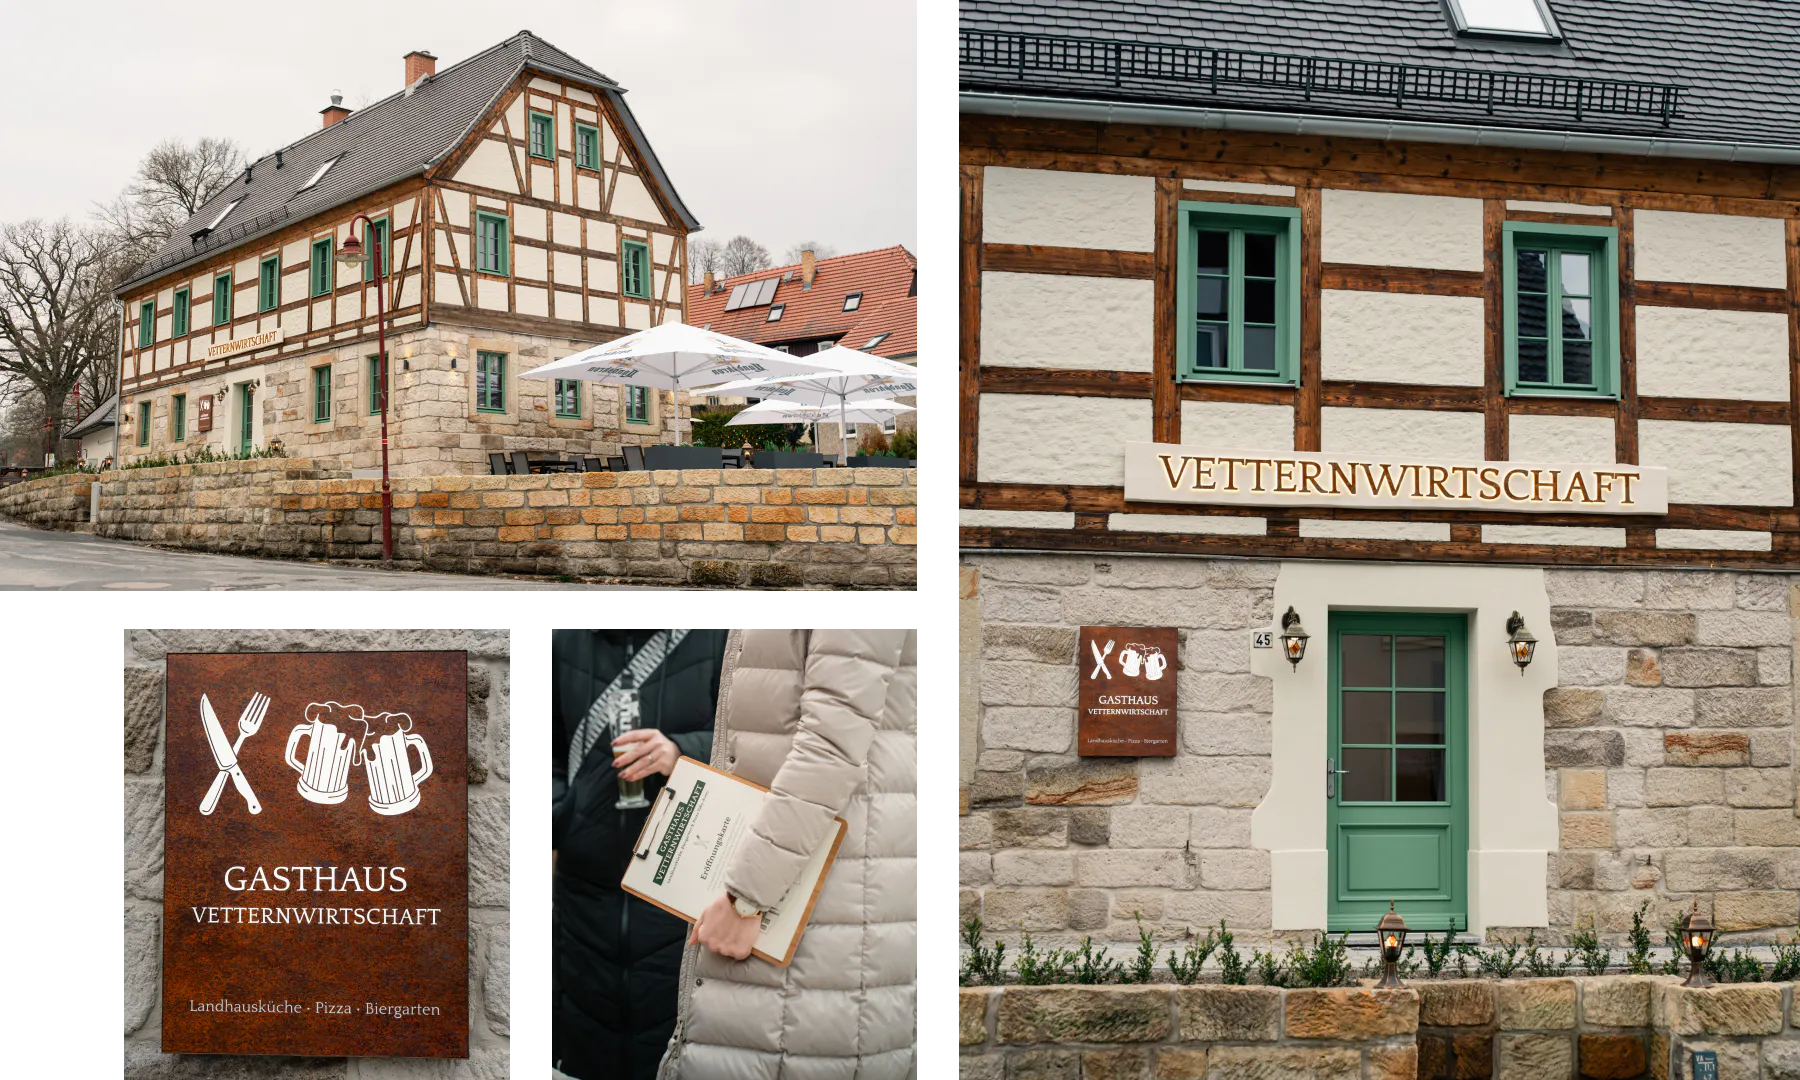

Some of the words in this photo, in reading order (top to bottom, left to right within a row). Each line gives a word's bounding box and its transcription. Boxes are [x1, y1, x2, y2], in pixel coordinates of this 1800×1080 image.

[207, 330, 278, 357] VETTERNWIRTSCHAFT
[1158, 454, 1641, 504] VETTERNWIRTSCHAFT
[1256, 634, 1271, 646] 45
[1088, 708, 1169, 716] VETTERNWIRTSCHAFT
[1098, 695, 1159, 705] GASTHAUS
[655, 783, 703, 882] VETTERNWIRTSCHAFT
[659, 805, 685, 853] GASTHAUS
[699, 815, 732, 881] Eröffnungskarte
[224, 866, 408, 893] GASTHAUS
[191, 906, 441, 926] VETTERNWIRTSCHAFT
[189, 998, 303, 1014] Landhausküche
[314, 1001, 352, 1015] Pizza
[364, 1001, 441, 1018] Biergarten
